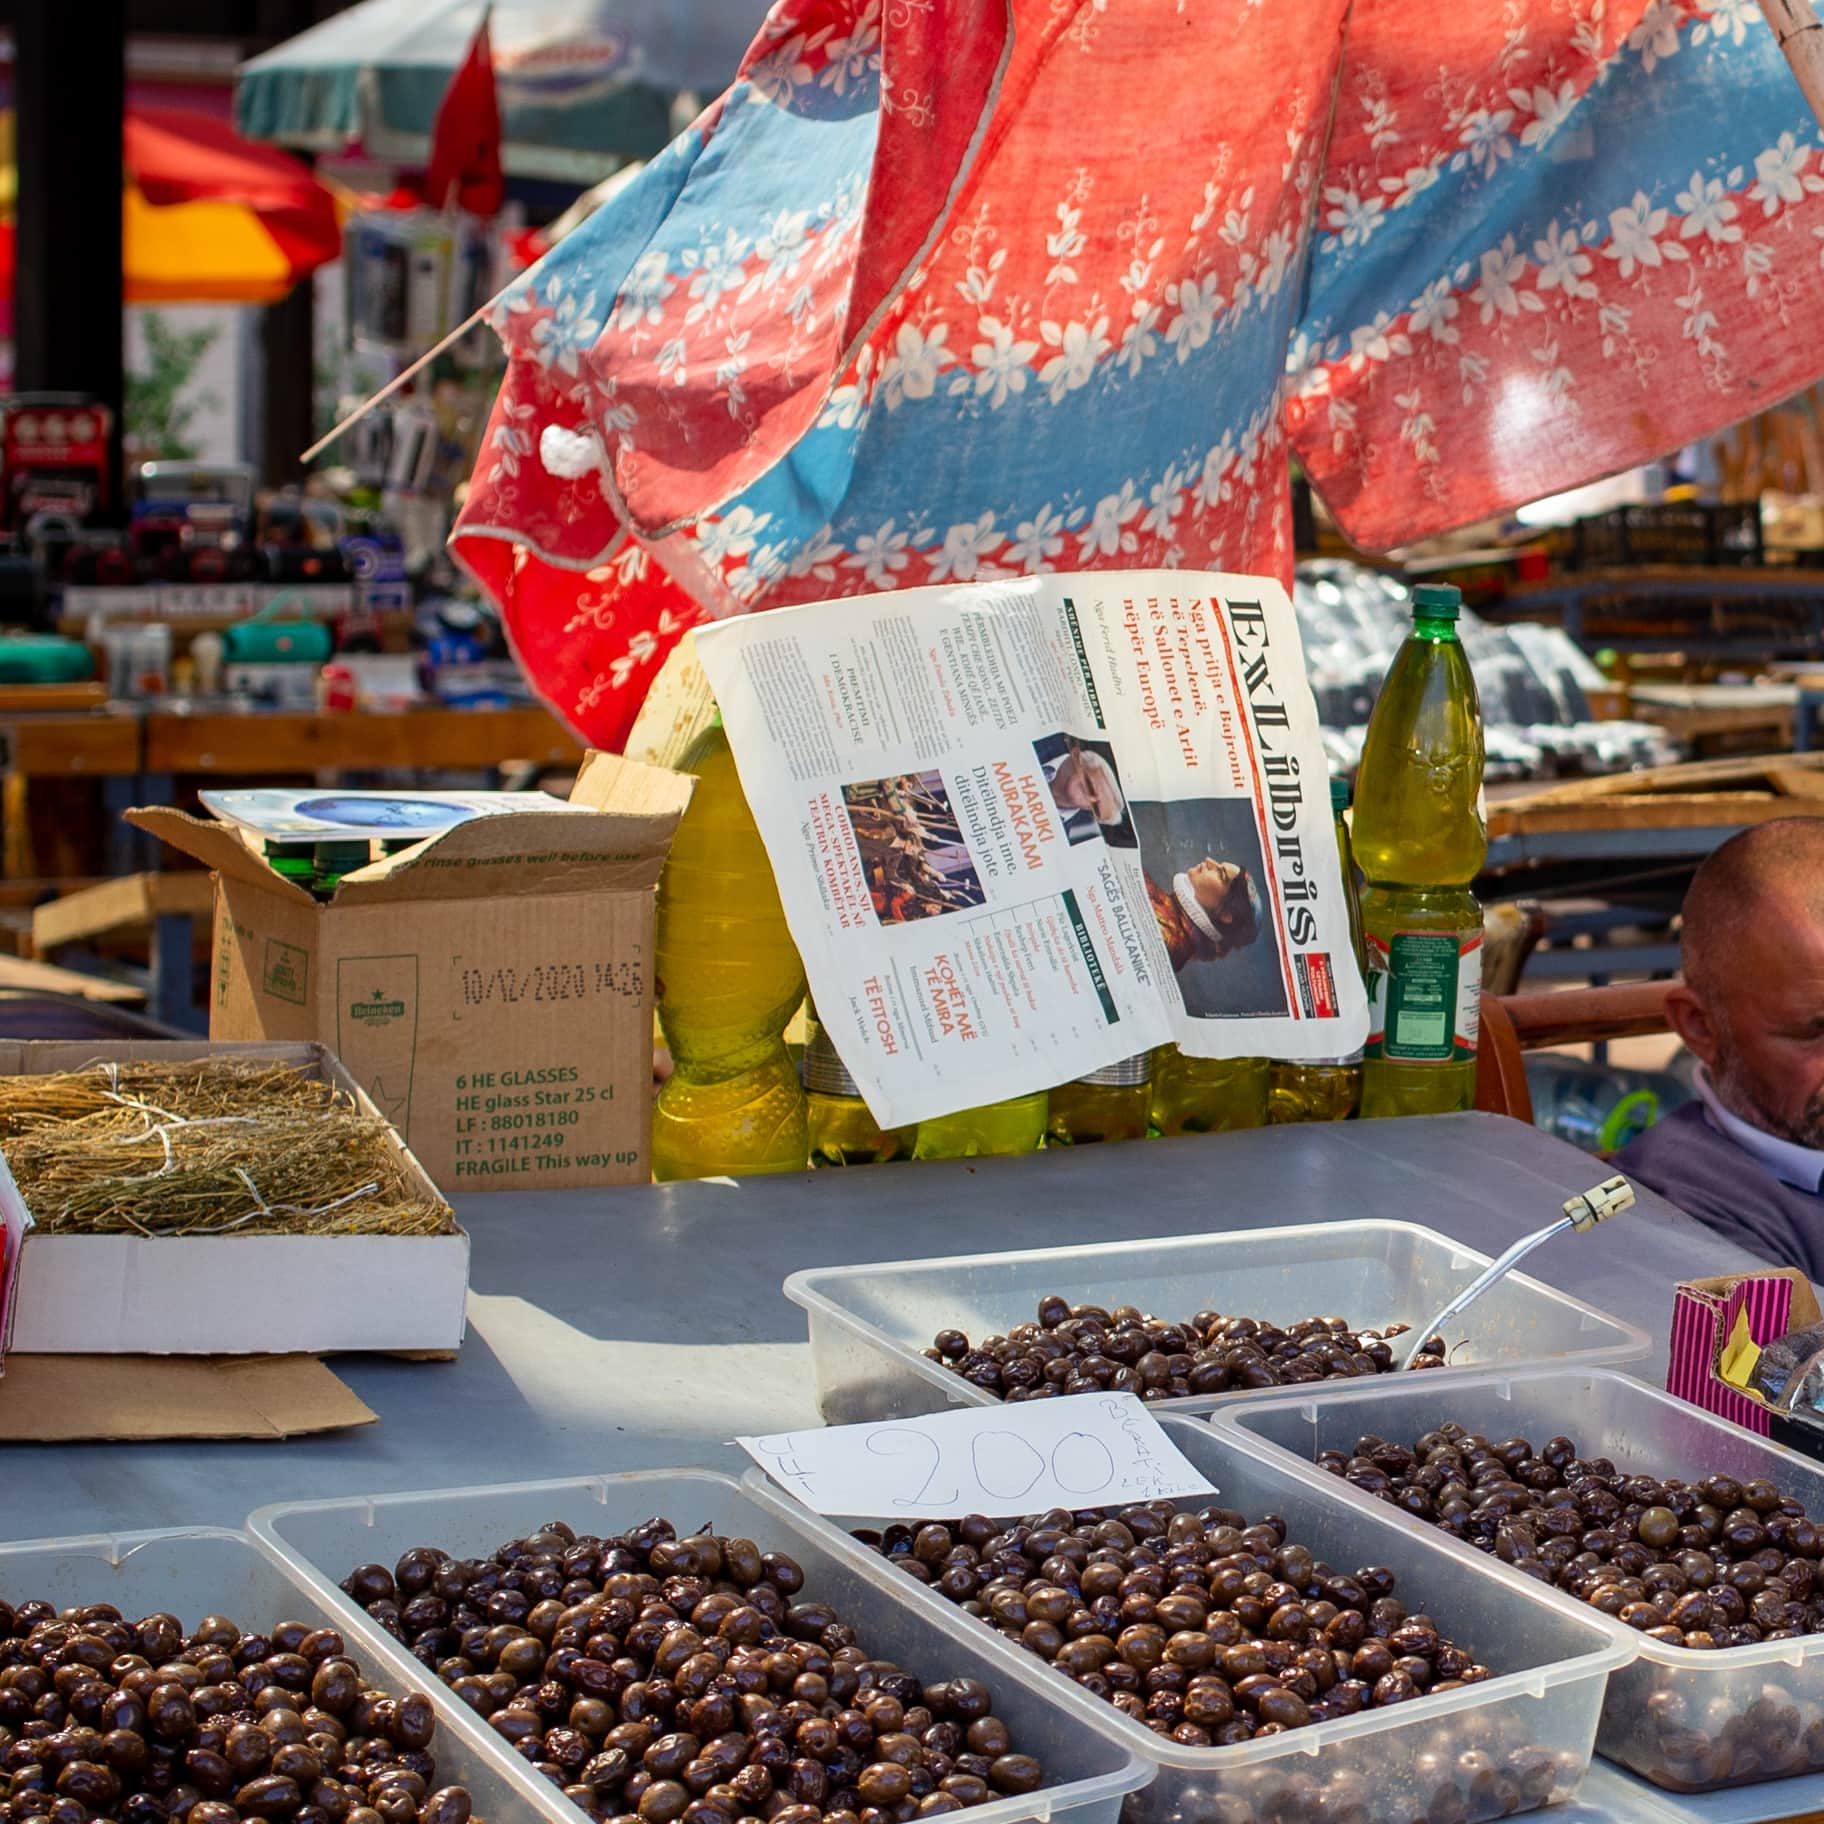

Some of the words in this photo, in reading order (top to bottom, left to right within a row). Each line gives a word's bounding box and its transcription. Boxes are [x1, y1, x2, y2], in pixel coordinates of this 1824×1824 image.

[1147, 597, 1166, 621] në
[1188, 599, 1208, 634] Nga
[1123, 599, 1144, 656] nëpër
[1136, 660, 1166, 730] Europë
[1153, 625, 1184, 705] Sallonet
[1169, 597, 1185, 621] në
[1177, 626, 1207, 717] Tepelenë,
[1196, 638, 1225, 684] pritja
[1176, 724, 1199, 768] Artit
[1219, 709, 1245, 790] Bajronit
[1225, 598, 1317, 945] ExLibris
[954, 775, 989, 849] ditëlindja
[978, 846, 999, 877] jote
[971, 765, 1006, 843] Ditëlindja
[992, 760, 1043, 871] MURAKAMI
[1018, 774, 1055, 843] HARUKI
[559, 851, 610, 863] before
[615, 851, 641, 862] use
[808, 799, 829, 855] TEATRIN
[822, 858, 851, 930] KOMBËTAR
[924, 967, 941, 987] TË
[1074, 923, 1106, 992] BIBLIOTEKË
[462, 965, 585, 1005] 10/12/2020
[863, 975, 883, 997] TË
[933, 954, 967, 1008] KOHËT
[954, 1012, 978, 1042] MË
[353, 1002, 402, 1017] Heineken
[868, 996, 899, 1056] FITOSH
[930, 988, 955, 1036] MIRA
[456, 1075, 467, 1090] 6
[471, 1073, 496, 1089] HE
[500, 1066, 579, 1087] GLASSES
[456, 1096, 481, 1112] HE
[485, 1093, 530, 1114] glass
[534, 1090, 570, 1106] Star
[575, 1087, 596, 1103] 25
[600, 1084, 614, 1101] cl
[456, 1118, 477, 1134] LF
[491, 1110, 580, 1131] 88018180
[456, 1139, 473, 1155] IT
[488, 1132, 565, 1153] 1141249
[455, 1156, 531, 1177] FRAGILE
[534, 1154, 572, 1170] This
[575, 1152, 612, 1169] way
[615, 1150, 638, 1167] up
[865, 1428, 1114, 1506] 200
